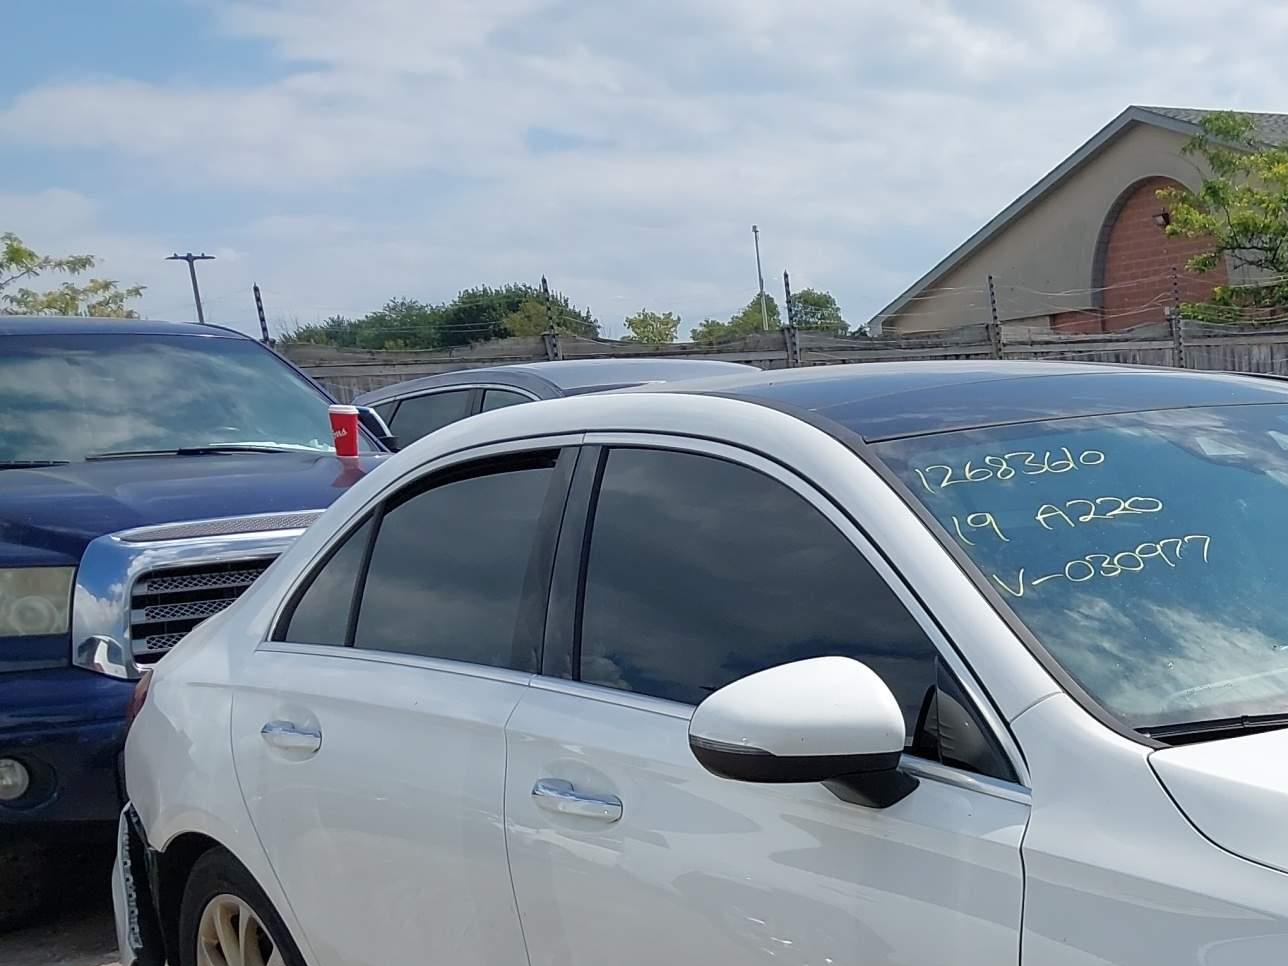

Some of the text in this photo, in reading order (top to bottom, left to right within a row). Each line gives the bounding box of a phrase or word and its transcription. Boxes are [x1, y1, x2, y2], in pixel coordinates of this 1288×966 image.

[914, 447, 1105, 494] 12683610
[951, 496, 1163, 546] 19 A220
[993, 534, 1211, 597] V-030977
